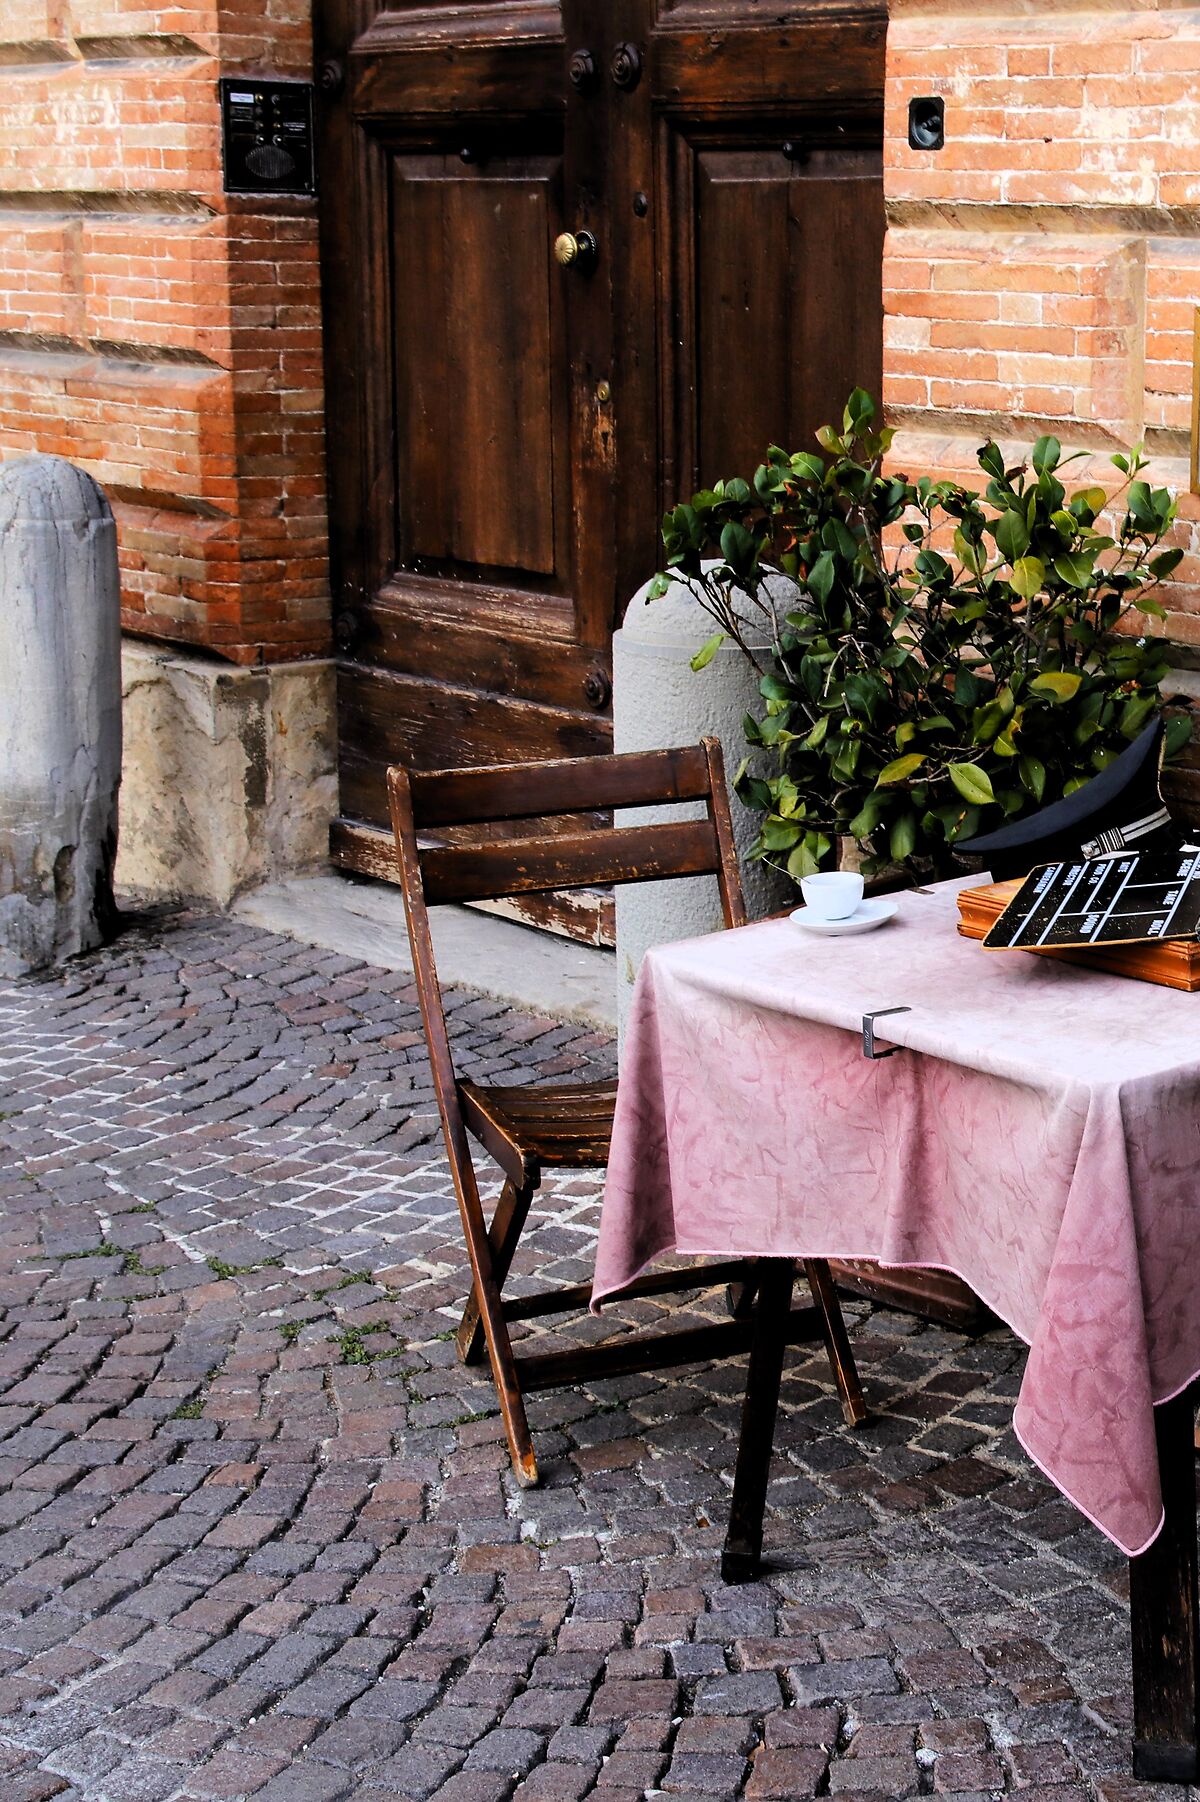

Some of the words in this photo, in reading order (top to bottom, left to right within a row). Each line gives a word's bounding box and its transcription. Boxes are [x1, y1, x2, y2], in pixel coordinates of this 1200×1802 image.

[1062, 865, 1082, 886] DIRECTOR
[1176, 859, 1194, 877] SCENE
[1032, 866, 1057, 894] CAMERAMAN
[1162, 889, 1180, 906] TAKE
[1079, 914, 1100, 934] SOUND
[1146, 919, 1165, 936] ROLL
